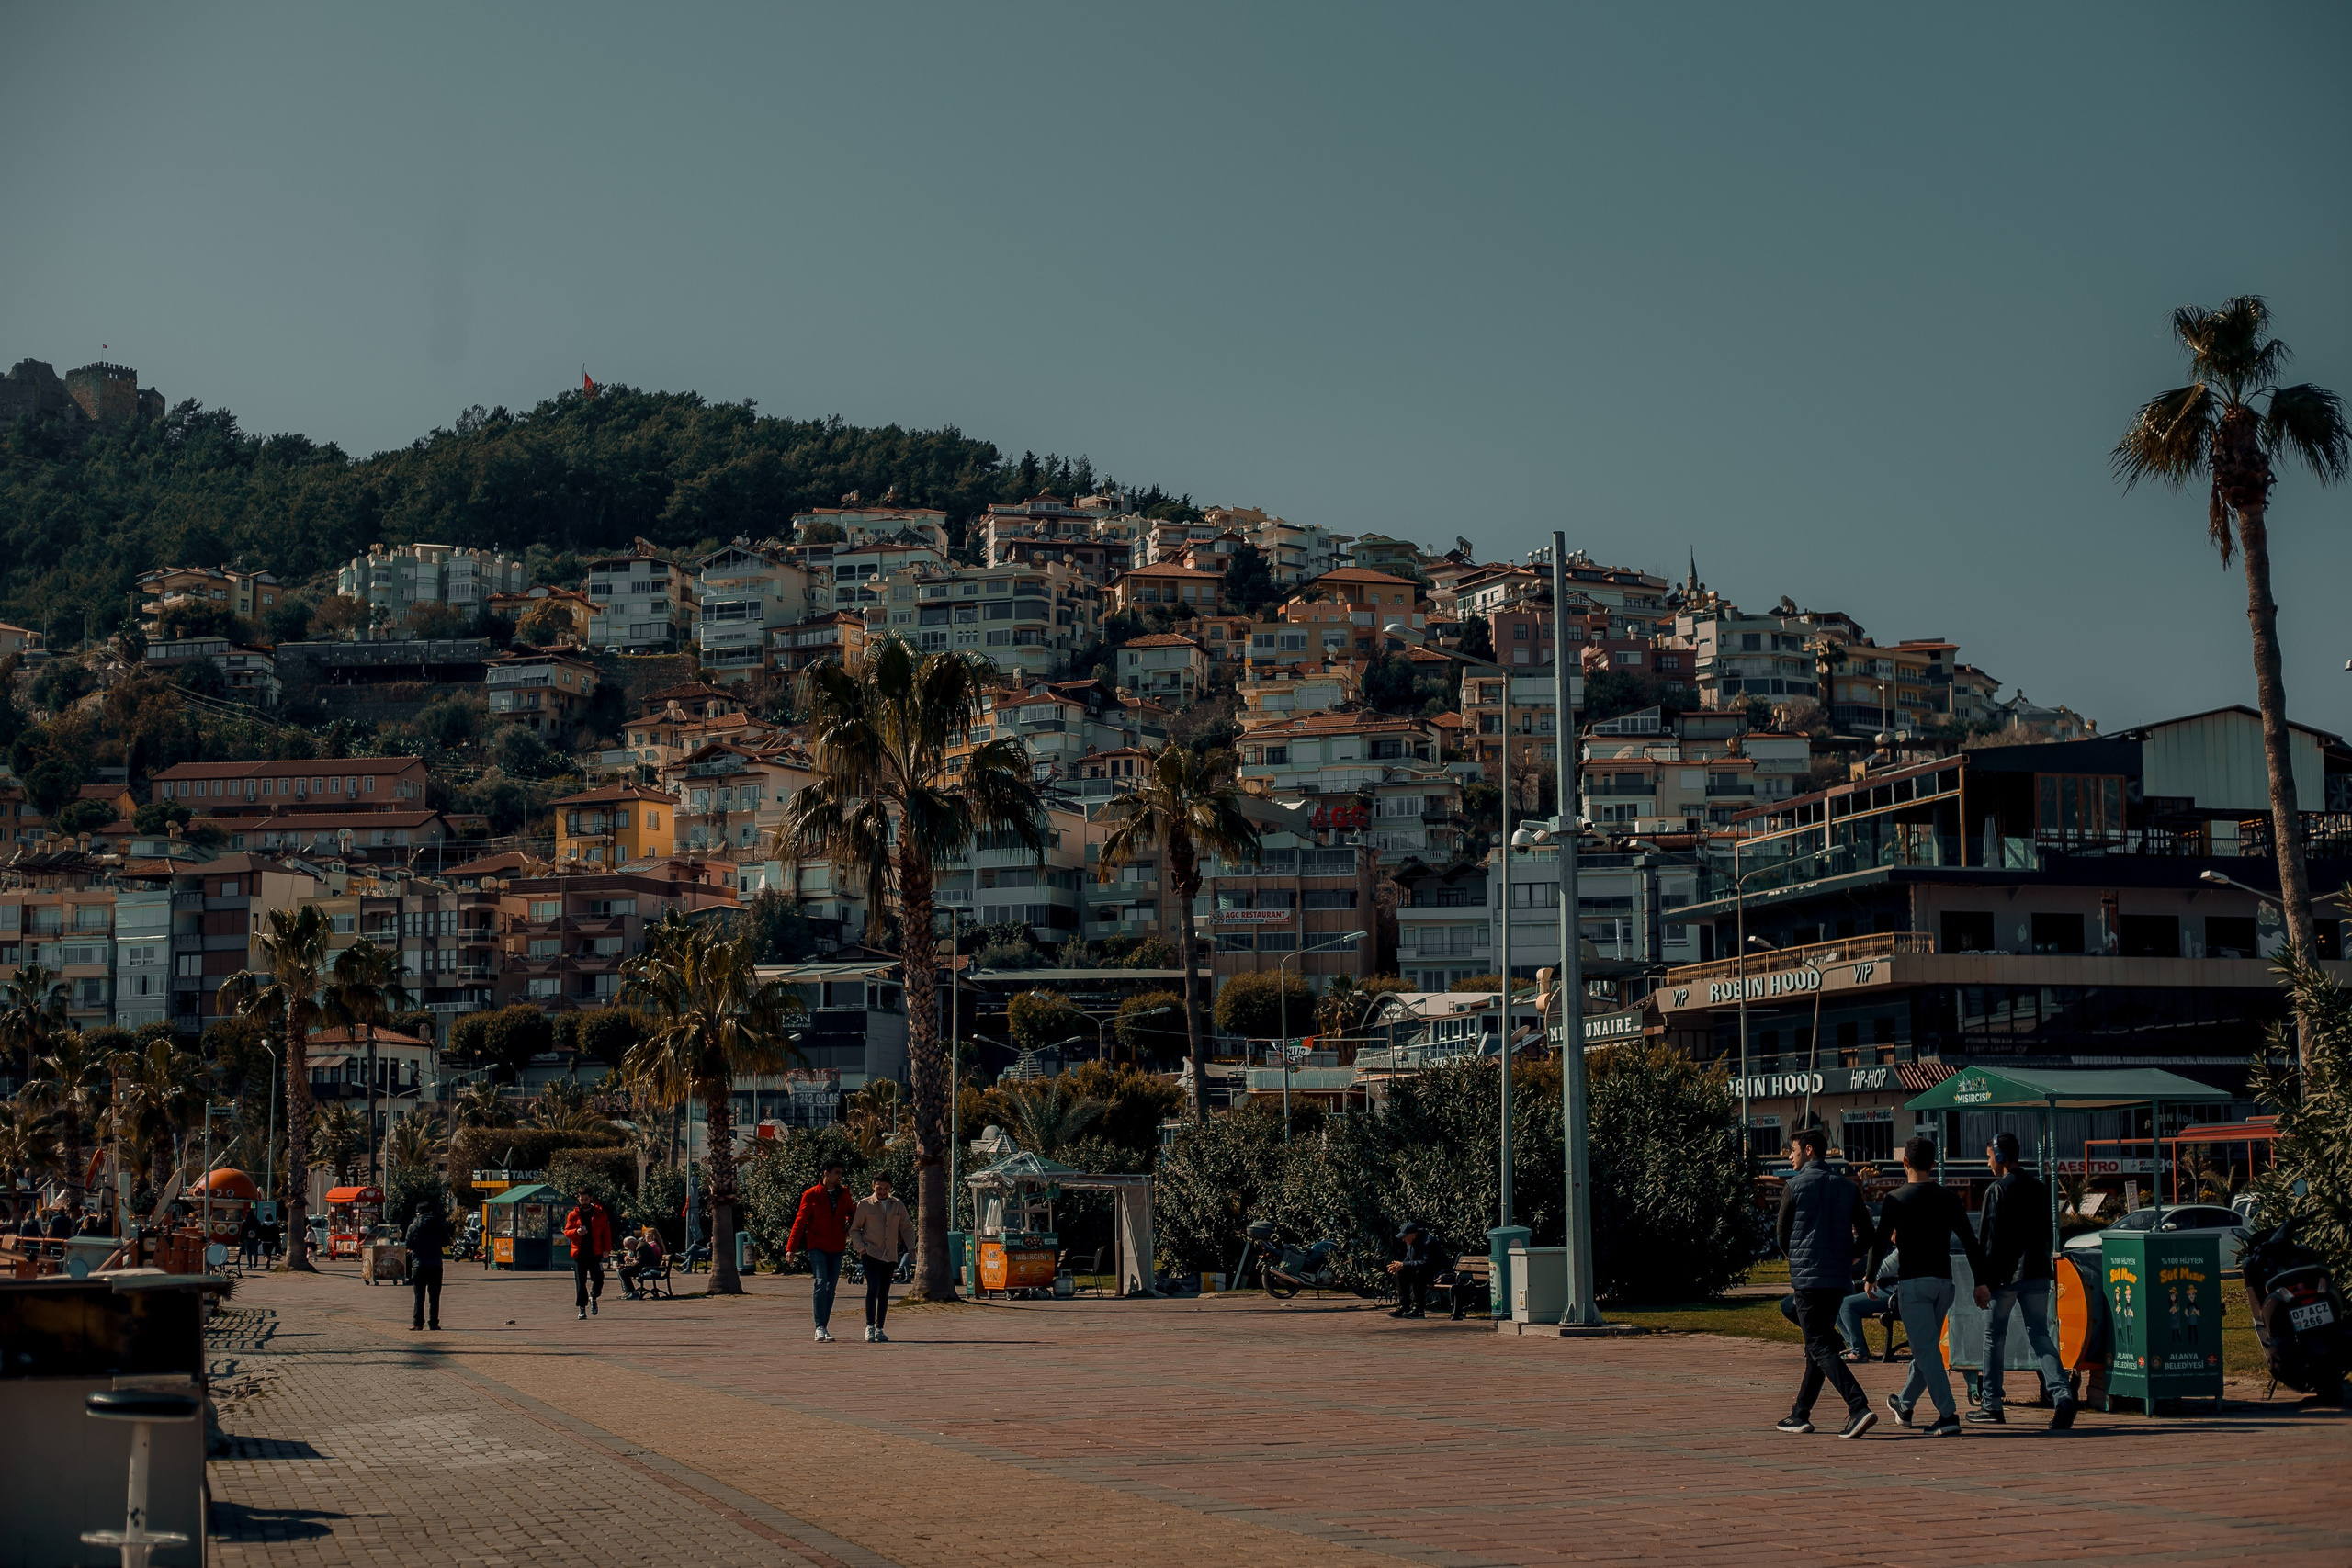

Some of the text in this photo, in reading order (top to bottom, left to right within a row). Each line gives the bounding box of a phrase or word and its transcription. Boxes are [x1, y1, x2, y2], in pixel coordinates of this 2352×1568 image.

[1311, 805, 1368, 827] AGC
[1241, 910, 1285, 919] RESTAURANT
[1853, 963, 1873, 984] VIP
[1709, 969, 1820, 1003] ROBIN HOOD
[1672, 988, 1689, 1007] VIP
[1771, 1073, 1824, 1096] HOOD
[1850, 1068, 1887, 1090] HIP-HOP
[816, 1093, 826, 1103] 00
[828, 1093, 840, 1103] 06
[1958, 1093, 1988, 1104] MISIRCISI
[1756, 1117, 1765, 1126] POP
[1848, 1112, 1866, 1121] TURKISH
[1866, 1111, 1876, 1121] POP
[2110, 1257, 2121, 1265] %100
[2292, 1303, 2329, 1320] 07 ACZ
[2303, 1315, 2323, 1328] 266
[2117, 1352, 2134, 1360] ALANYA
[2170, 1352, 2199, 1360] ALANYA
